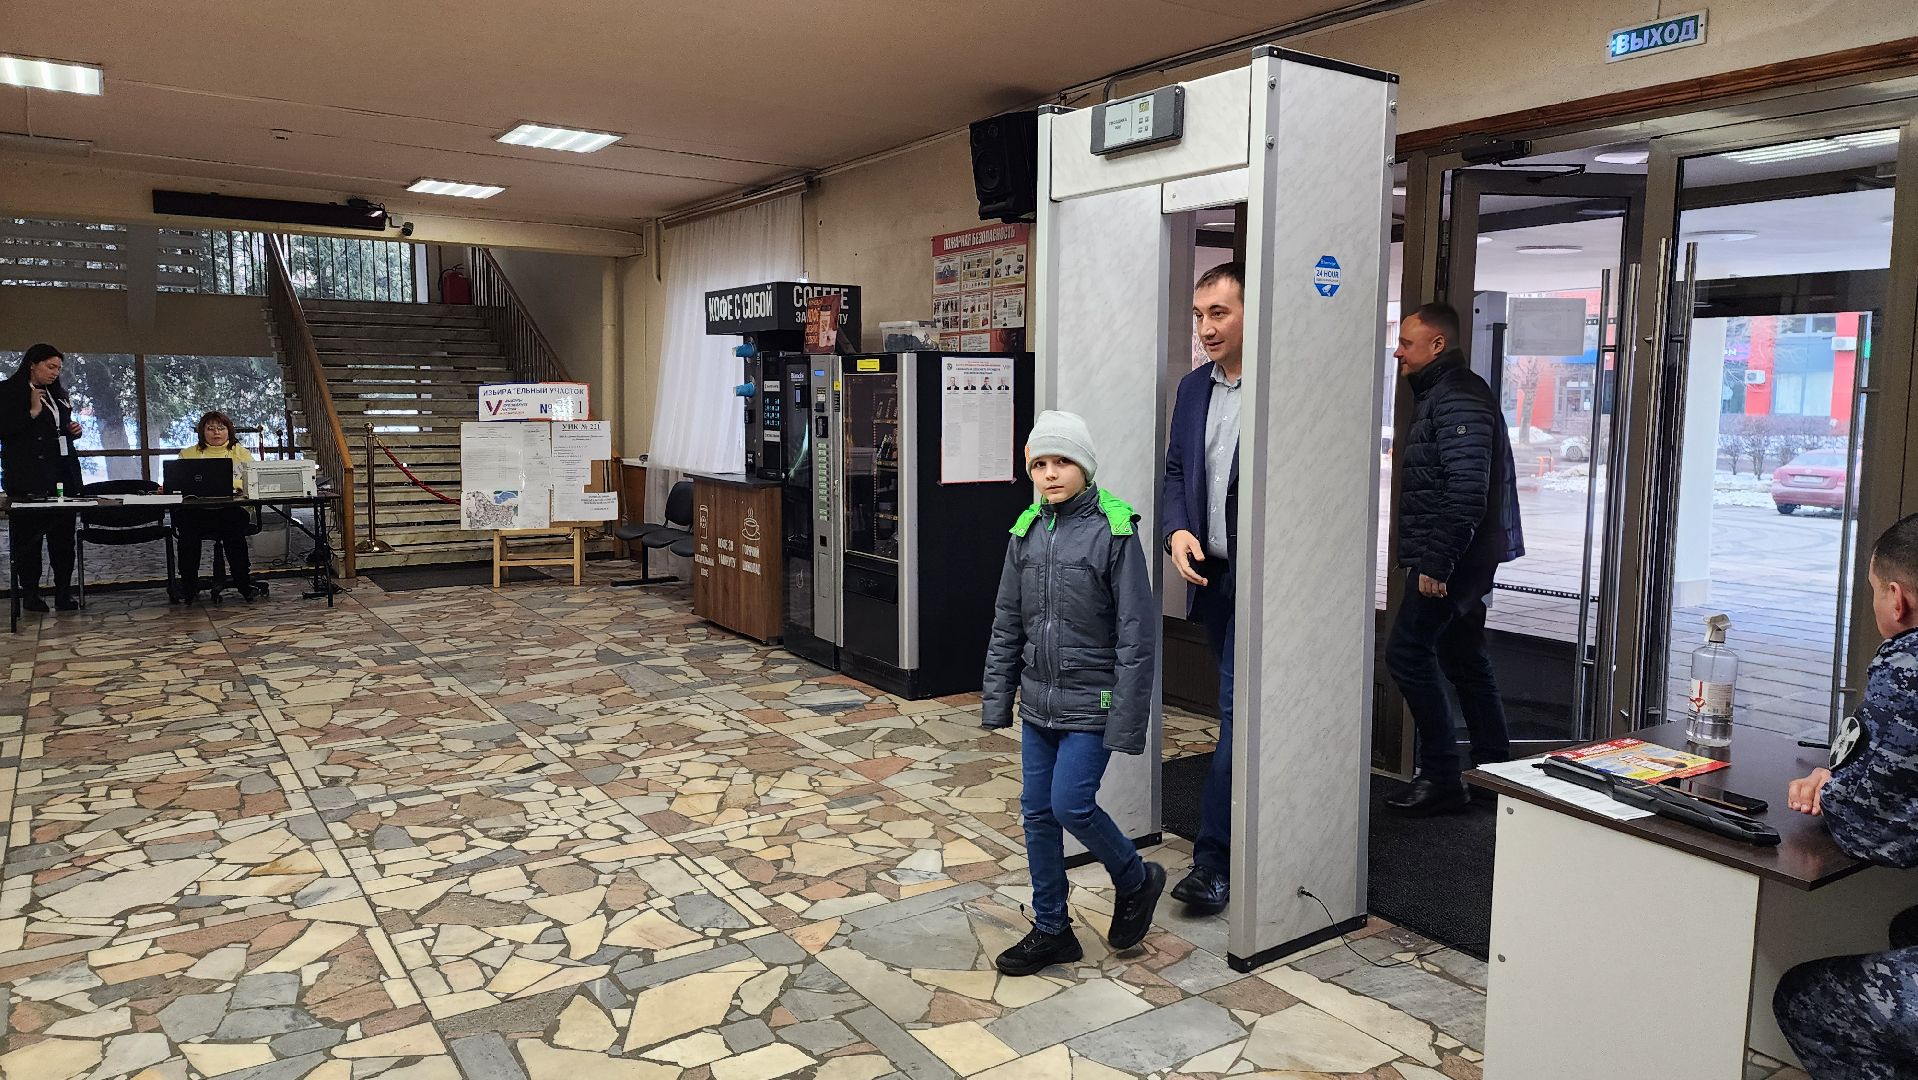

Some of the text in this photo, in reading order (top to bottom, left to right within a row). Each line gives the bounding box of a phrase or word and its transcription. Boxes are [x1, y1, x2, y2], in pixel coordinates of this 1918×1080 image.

[1615, 20, 1696, 55] ВЫХОД
[943, 225, 1016, 251] ПОЖАРНАЯ БЕЗОПАСНОСТЬ
[1323, 270, 1339, 279] HOUR
[708, 285, 773, 322] КОФЕ С СОБОЙ
[549, 387, 584, 396] УЧАСТОК
